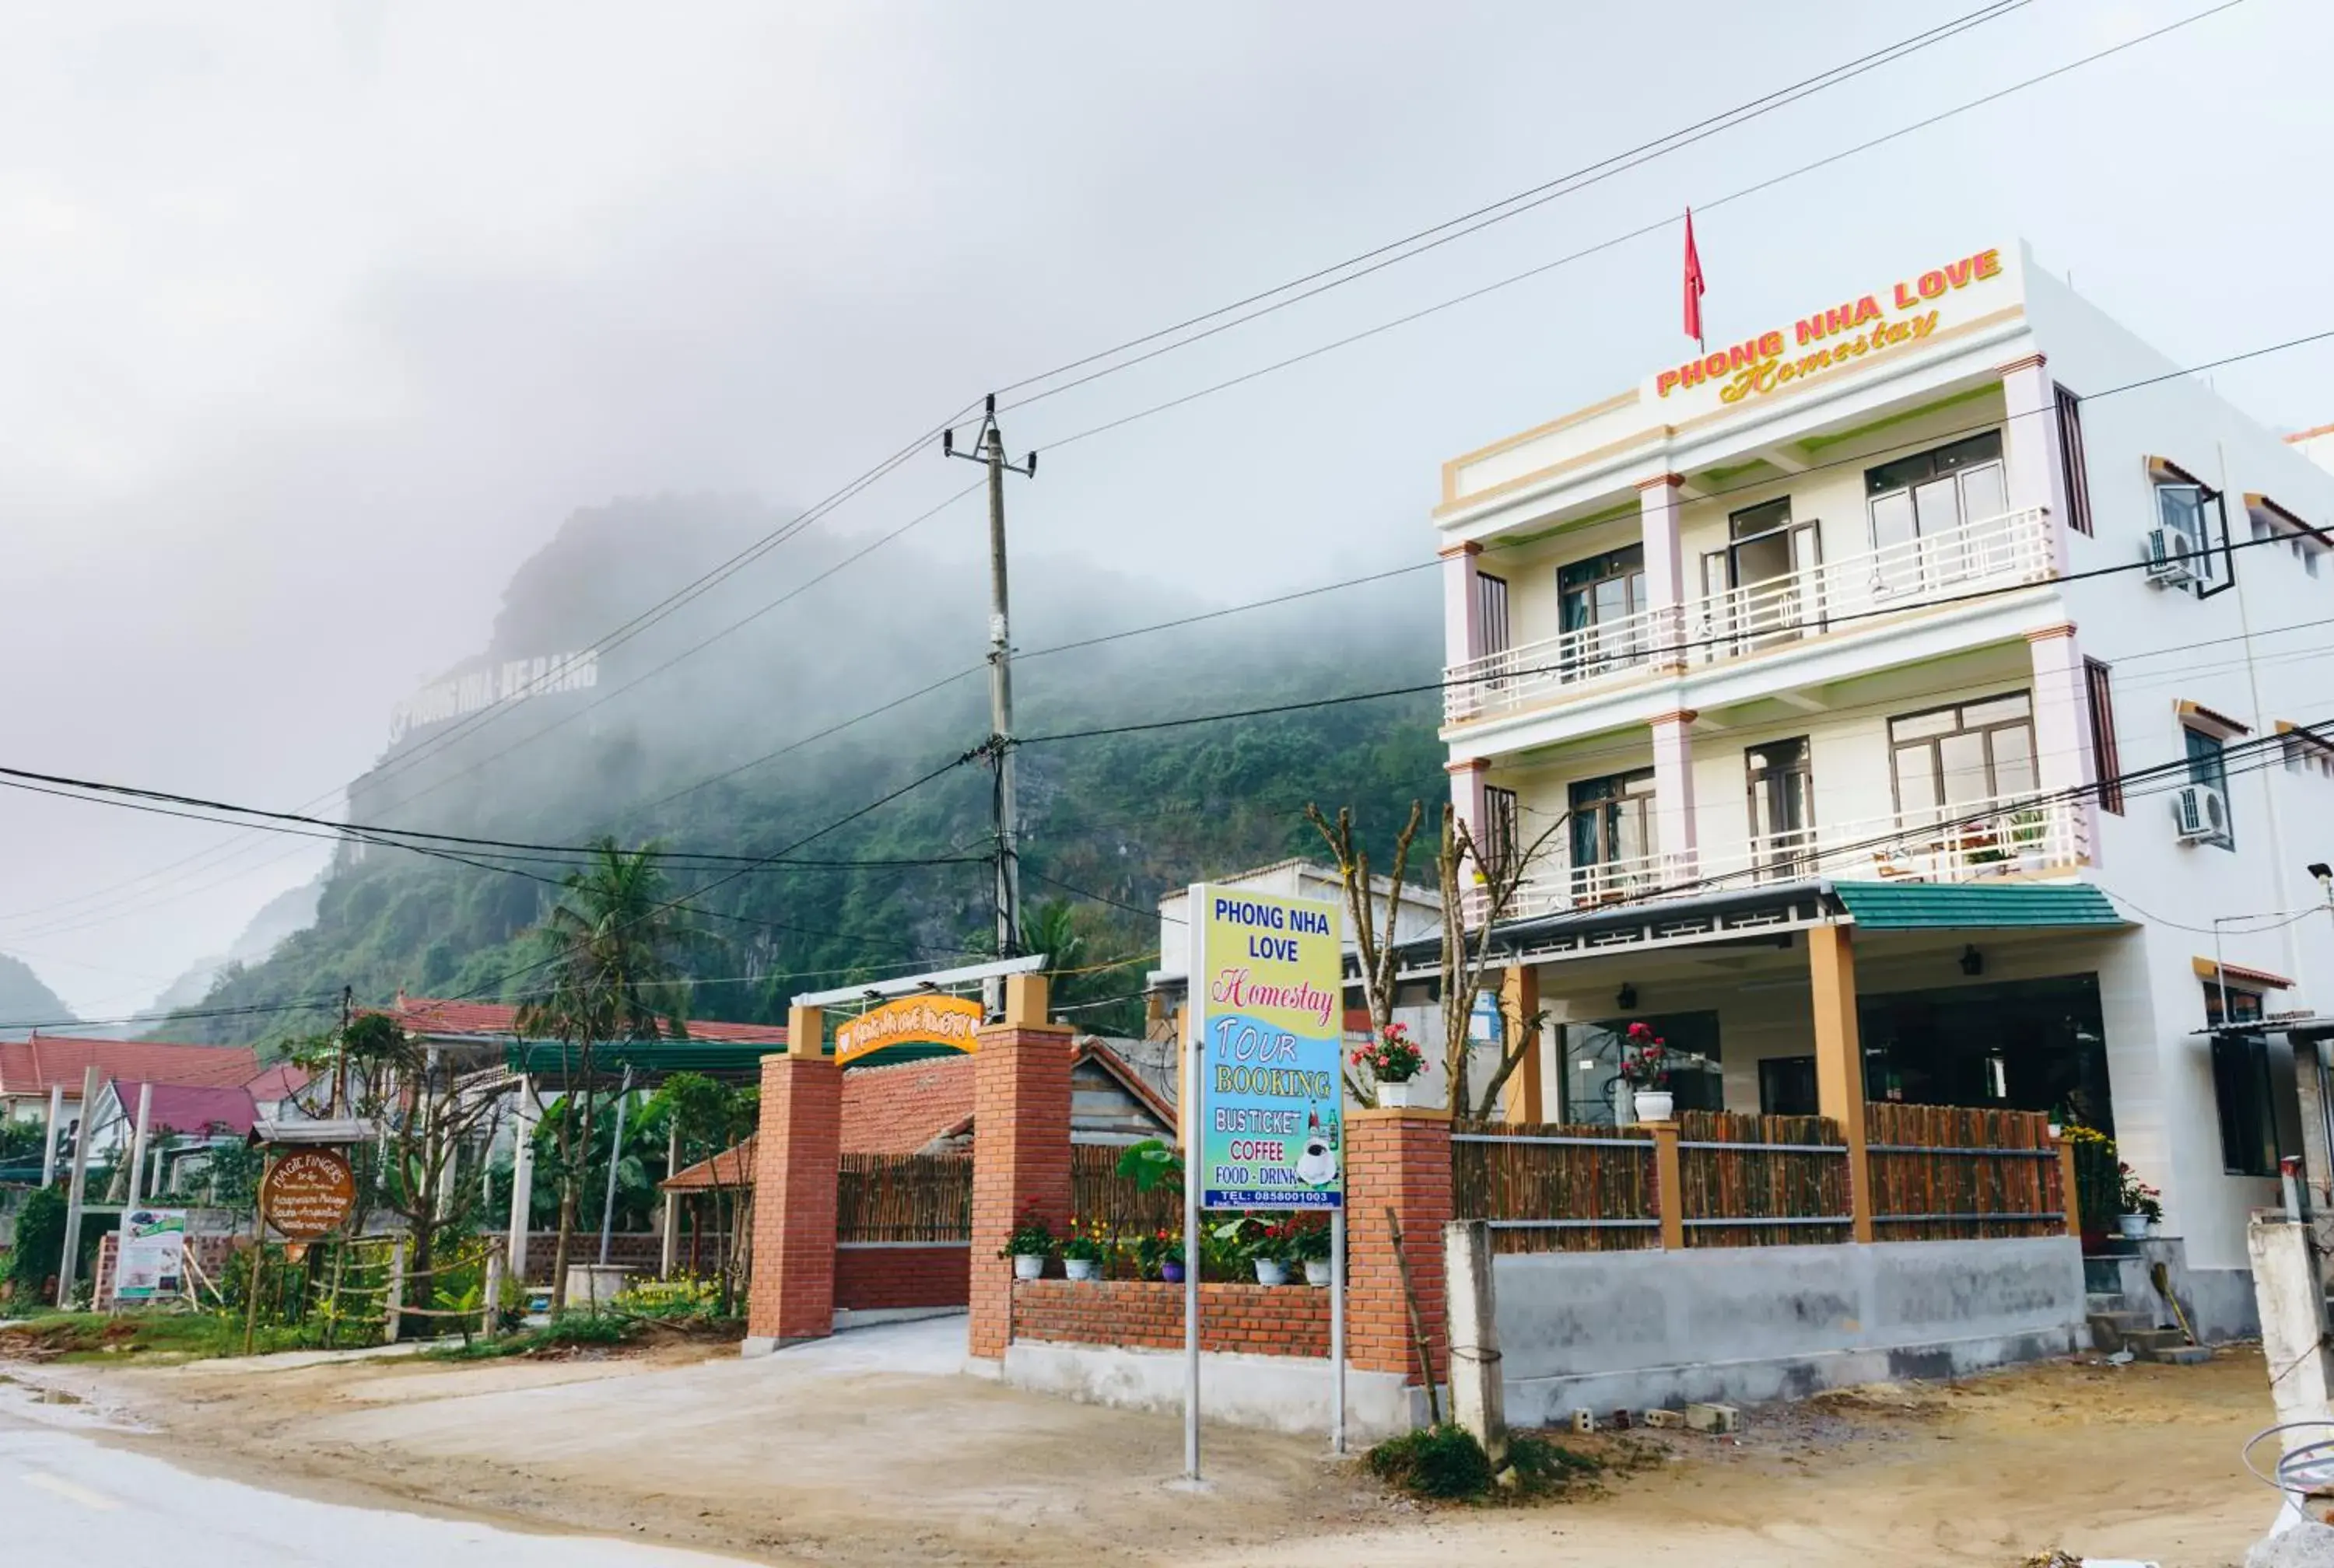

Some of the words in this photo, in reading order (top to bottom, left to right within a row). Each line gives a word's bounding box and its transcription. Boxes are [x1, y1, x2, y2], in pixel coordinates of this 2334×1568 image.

[1656, 330, 1784, 398] PHONG
[1796, 293, 1883, 346] NHA
[1894, 248, 2003, 310] LOVE
[1719, 310, 1939, 404] Homestay
[1215, 898, 1283, 929] PHONG
[1290, 909, 1330, 936] NHA
[1249, 935, 1298, 962] LOVE
[1211, 969, 1334, 1027] Homestay
[1215, 1017, 1297, 1062] TOUR
[1215, 1064, 1331, 1100] BOOKING
[1215, 1108, 1246, 1132] BUS
[1248, 1109, 1302, 1136] TICKET
[1230, 1140, 1284, 1160] COFFEE
[272, 1157, 303, 1188] MAGIC
[1215, 1167, 1249, 1185] FOOD
[1259, 1167, 1298, 1185] DRINK
[1221, 1191, 1251, 1200] TEL:
